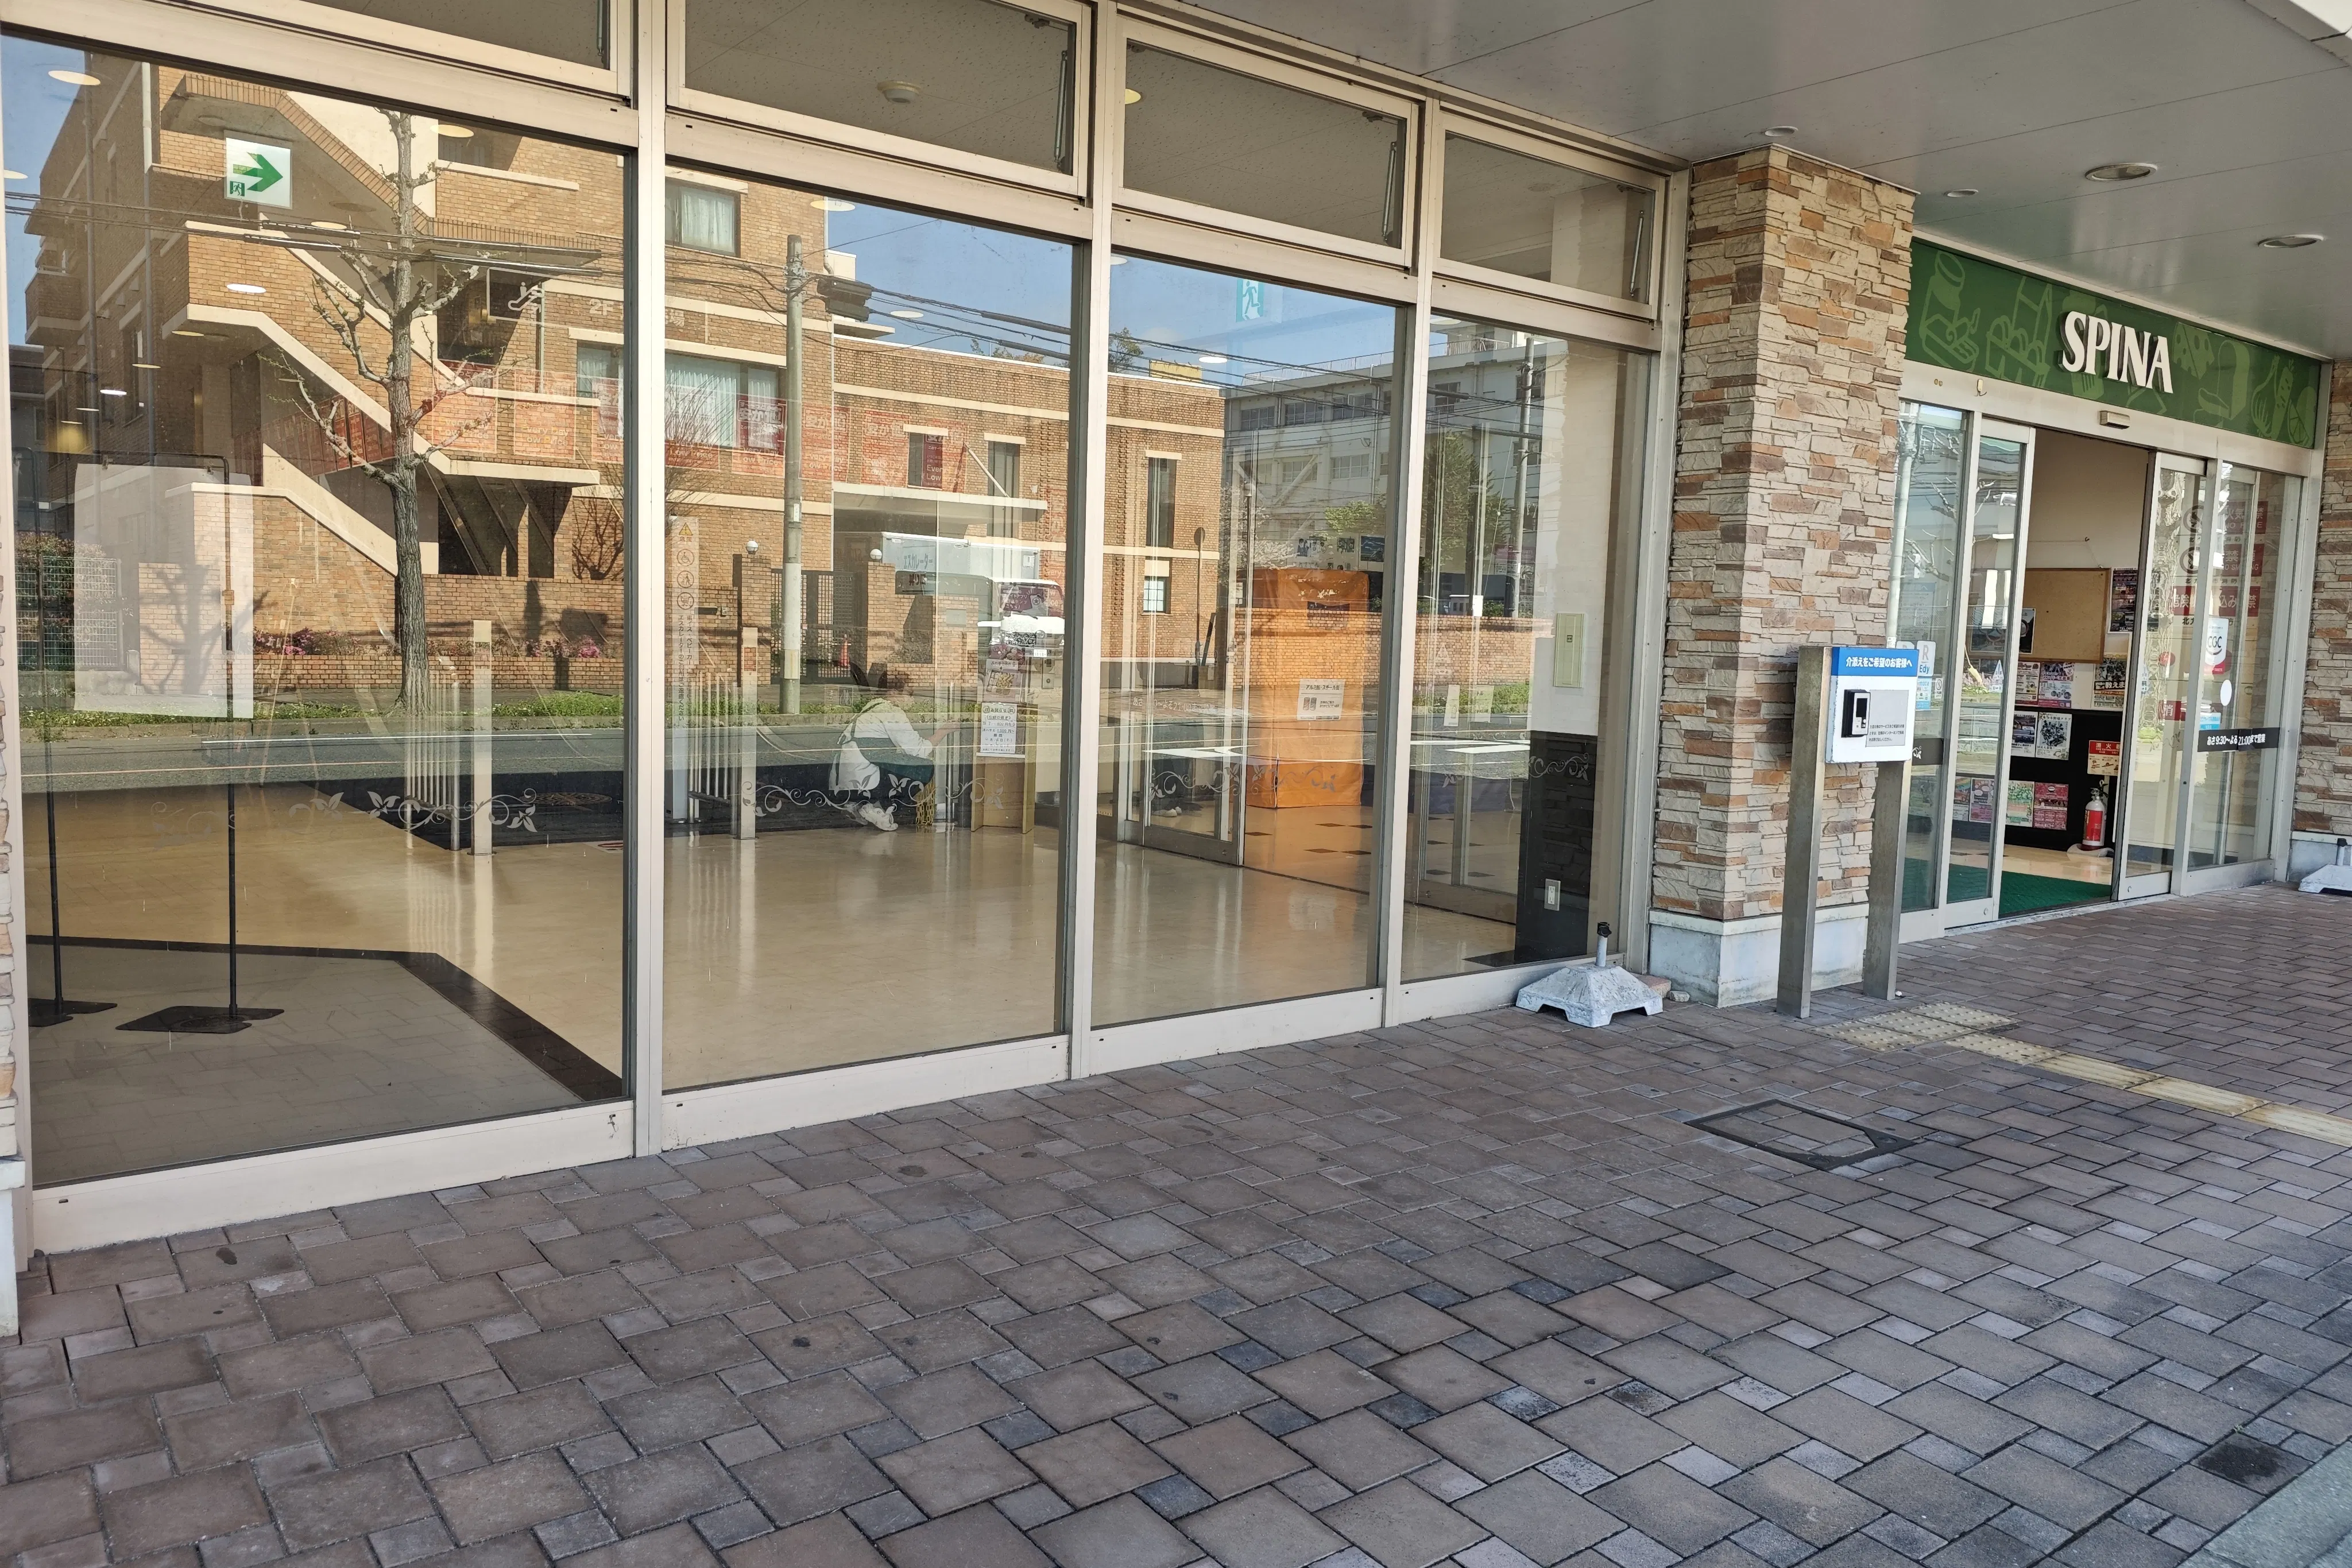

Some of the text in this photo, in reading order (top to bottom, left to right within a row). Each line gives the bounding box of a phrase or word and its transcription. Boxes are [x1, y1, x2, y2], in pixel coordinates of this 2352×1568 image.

[2060, 311, 2173, 394] SPINA
[2226, 507, 2264, 520] 火気禁
[2207, 636, 2222, 648] CGC
[1846, 656, 1913, 668] 介添えをご希望のお客様へ
[1919, 664, 1930, 675] Edy
